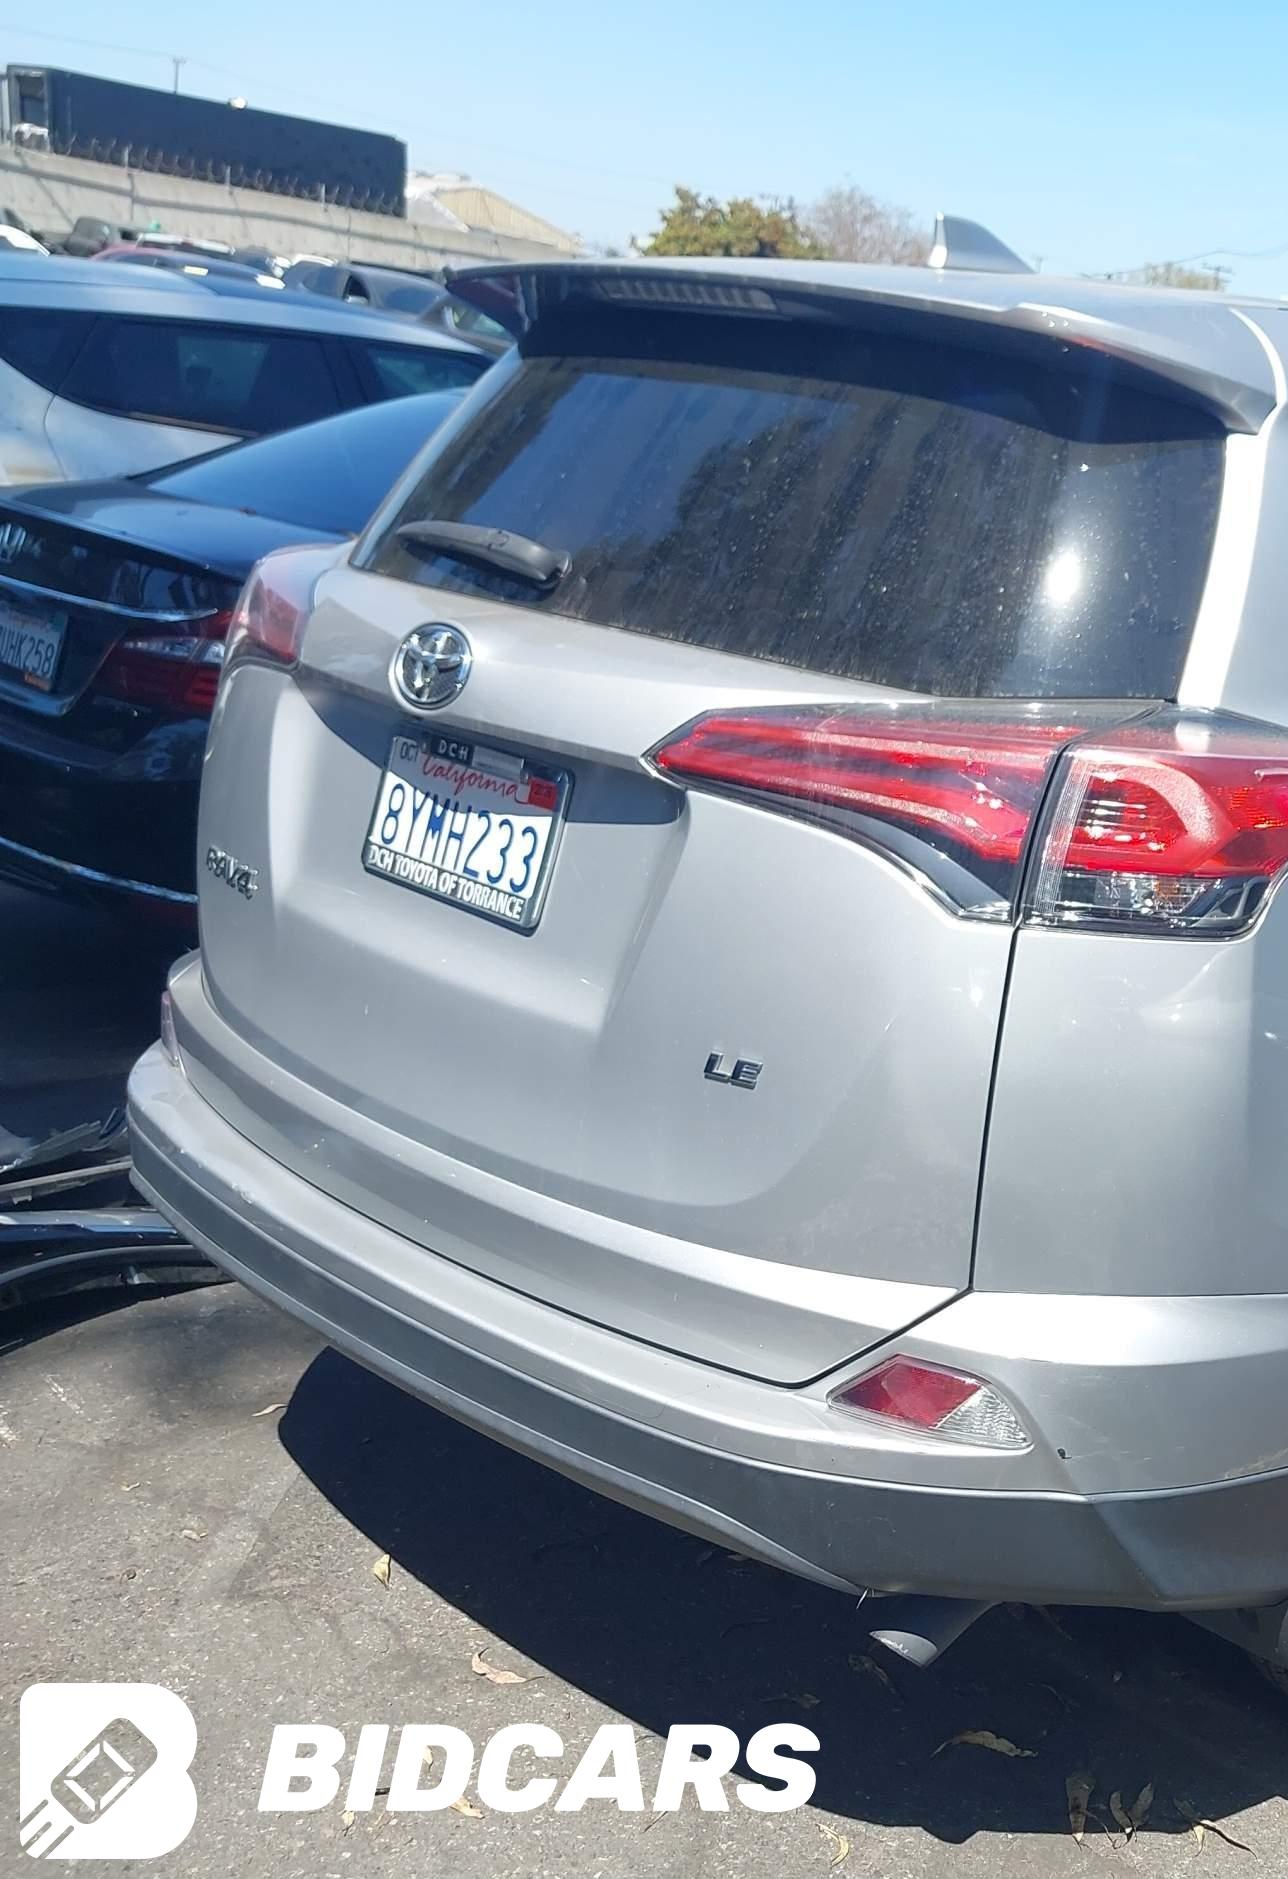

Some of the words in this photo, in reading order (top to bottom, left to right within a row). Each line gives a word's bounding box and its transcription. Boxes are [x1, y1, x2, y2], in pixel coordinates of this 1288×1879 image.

[439, 739, 469, 760] DCH
[421, 752, 528, 804] California
[381, 783, 538, 893] 8YMH233
[369, 845, 394, 871] DCH
[395, 854, 438, 889] TOYOTA
[438, 871, 458, 895] OF
[457, 878, 524, 920] TORRANCE
[704, 1051, 763, 1090] LE
